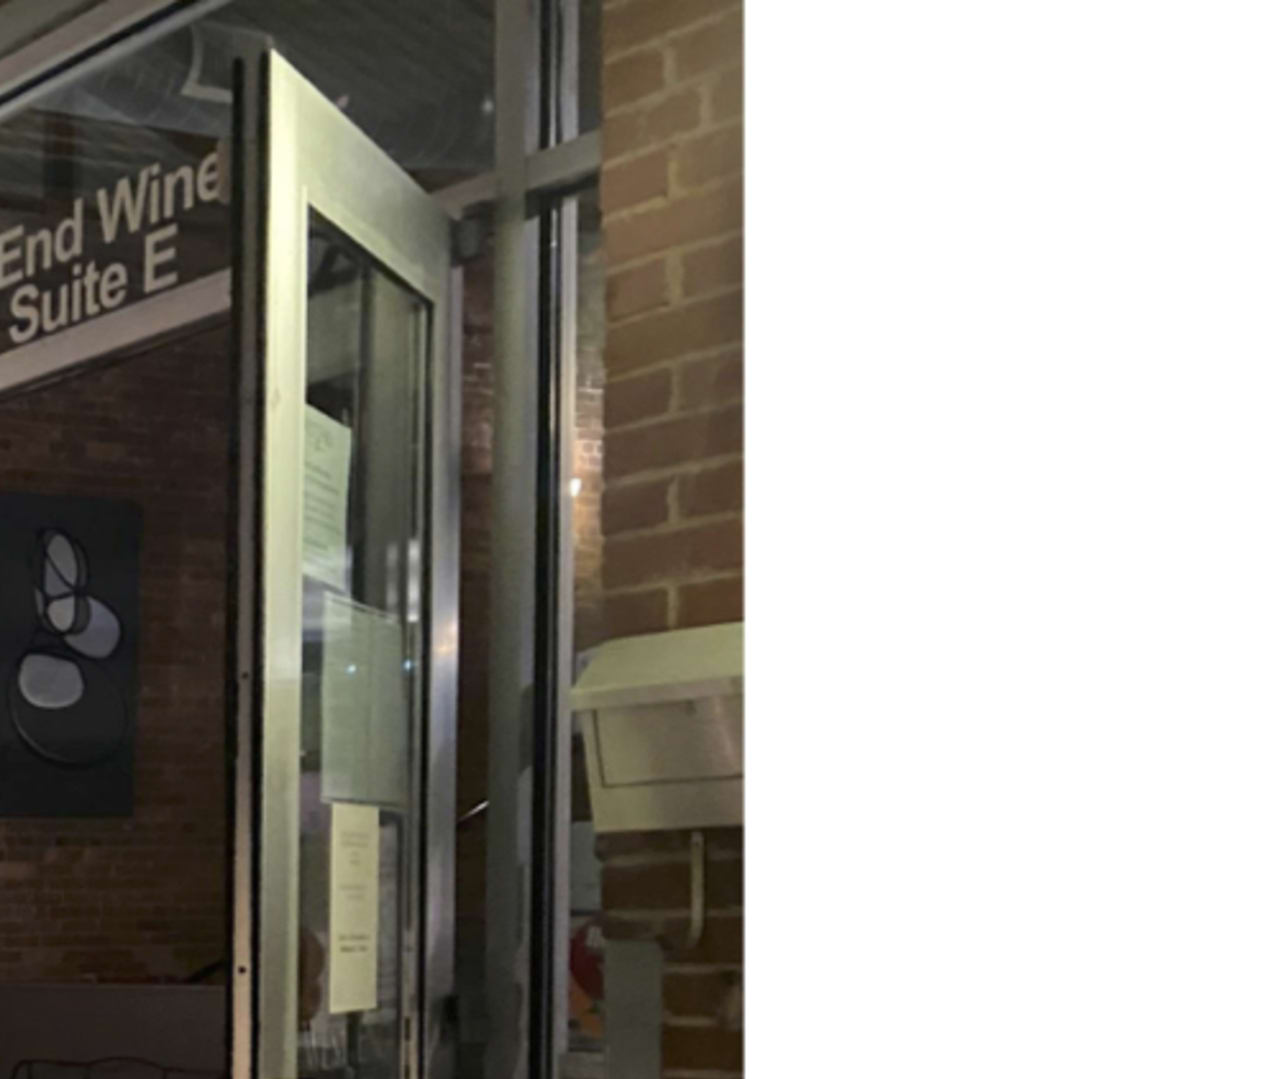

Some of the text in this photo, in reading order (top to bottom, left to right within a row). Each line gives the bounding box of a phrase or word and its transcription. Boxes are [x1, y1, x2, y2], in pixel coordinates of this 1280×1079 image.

[97, 150, 222, 245] Wine
[9, 224, 179, 345] Suite E
